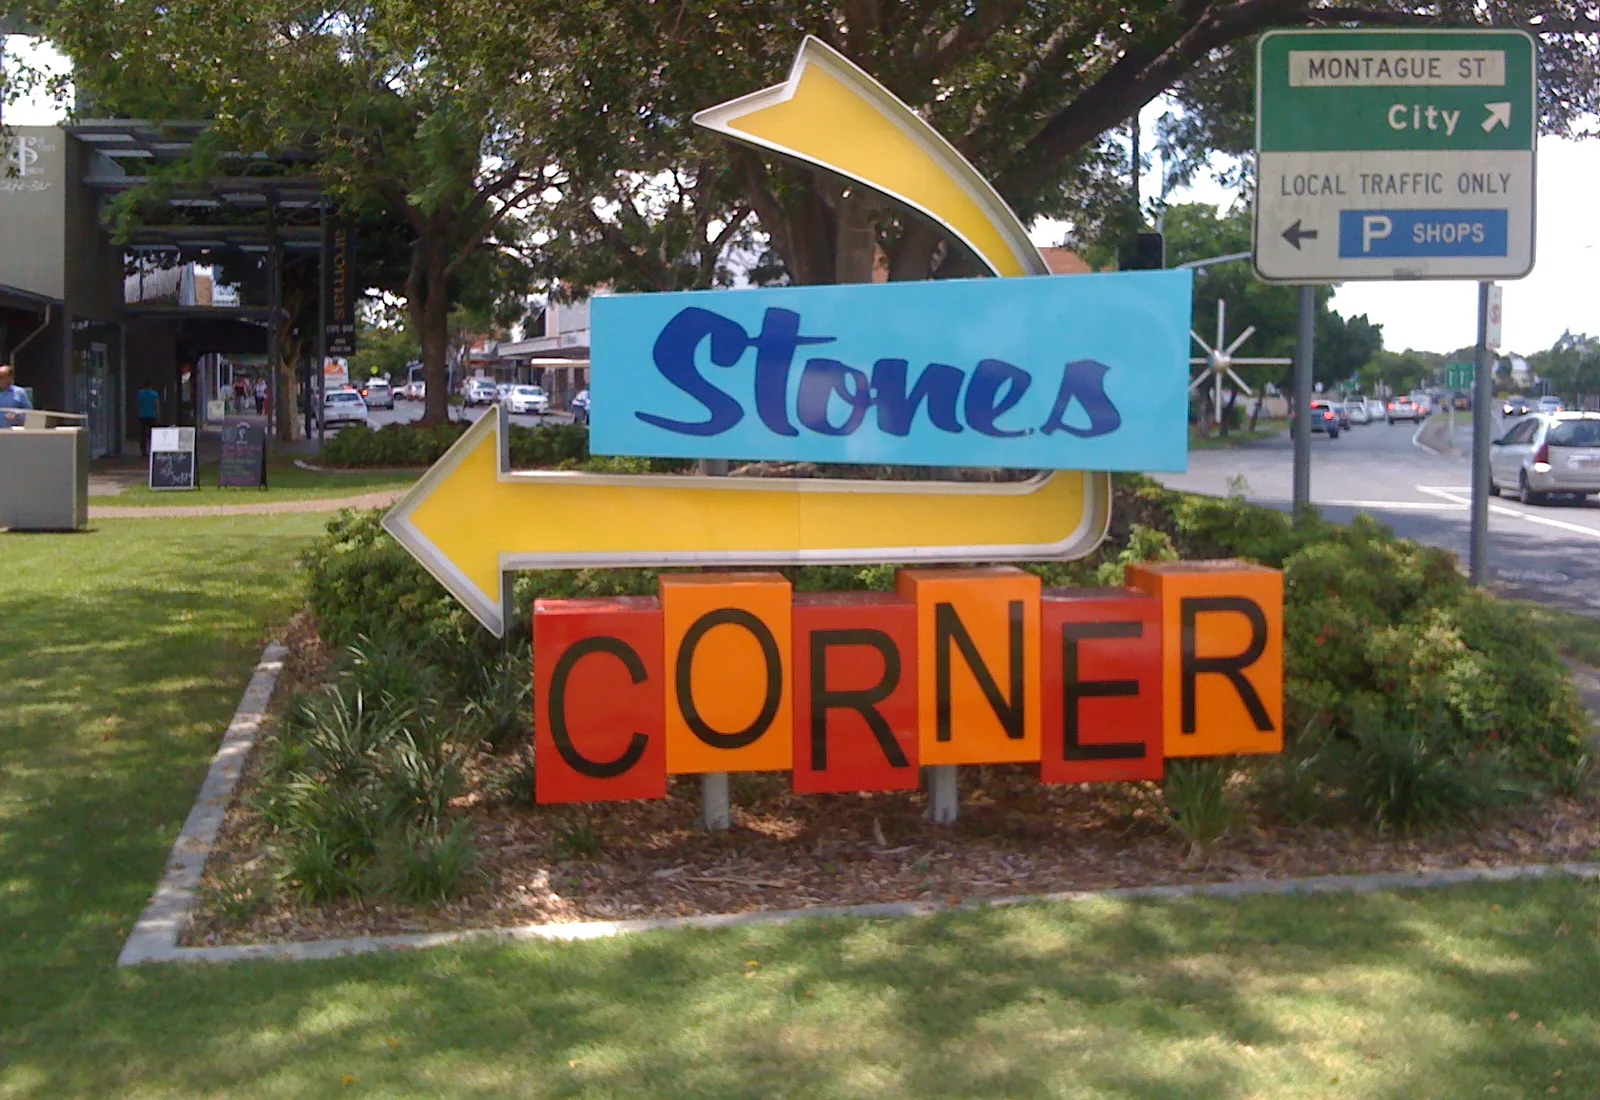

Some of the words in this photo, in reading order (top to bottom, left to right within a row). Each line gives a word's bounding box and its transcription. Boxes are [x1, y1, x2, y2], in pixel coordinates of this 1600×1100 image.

[1308, 57, 1441, 79] MONTAGUE
[1458, 57, 1486, 78] ST
[1387, 103, 1460, 136] City
[1281, 174, 1347, 196] LOCAL
[1359, 172, 1444, 194] TRAFFIC
[1457, 172, 1511, 194] ONLY
[1362, 214, 1393, 253] P
[1412, 222, 1485, 243] SHOPS
[634, 306, 1121, 438] Stones
[547, 595, 1276, 779] CORNER
